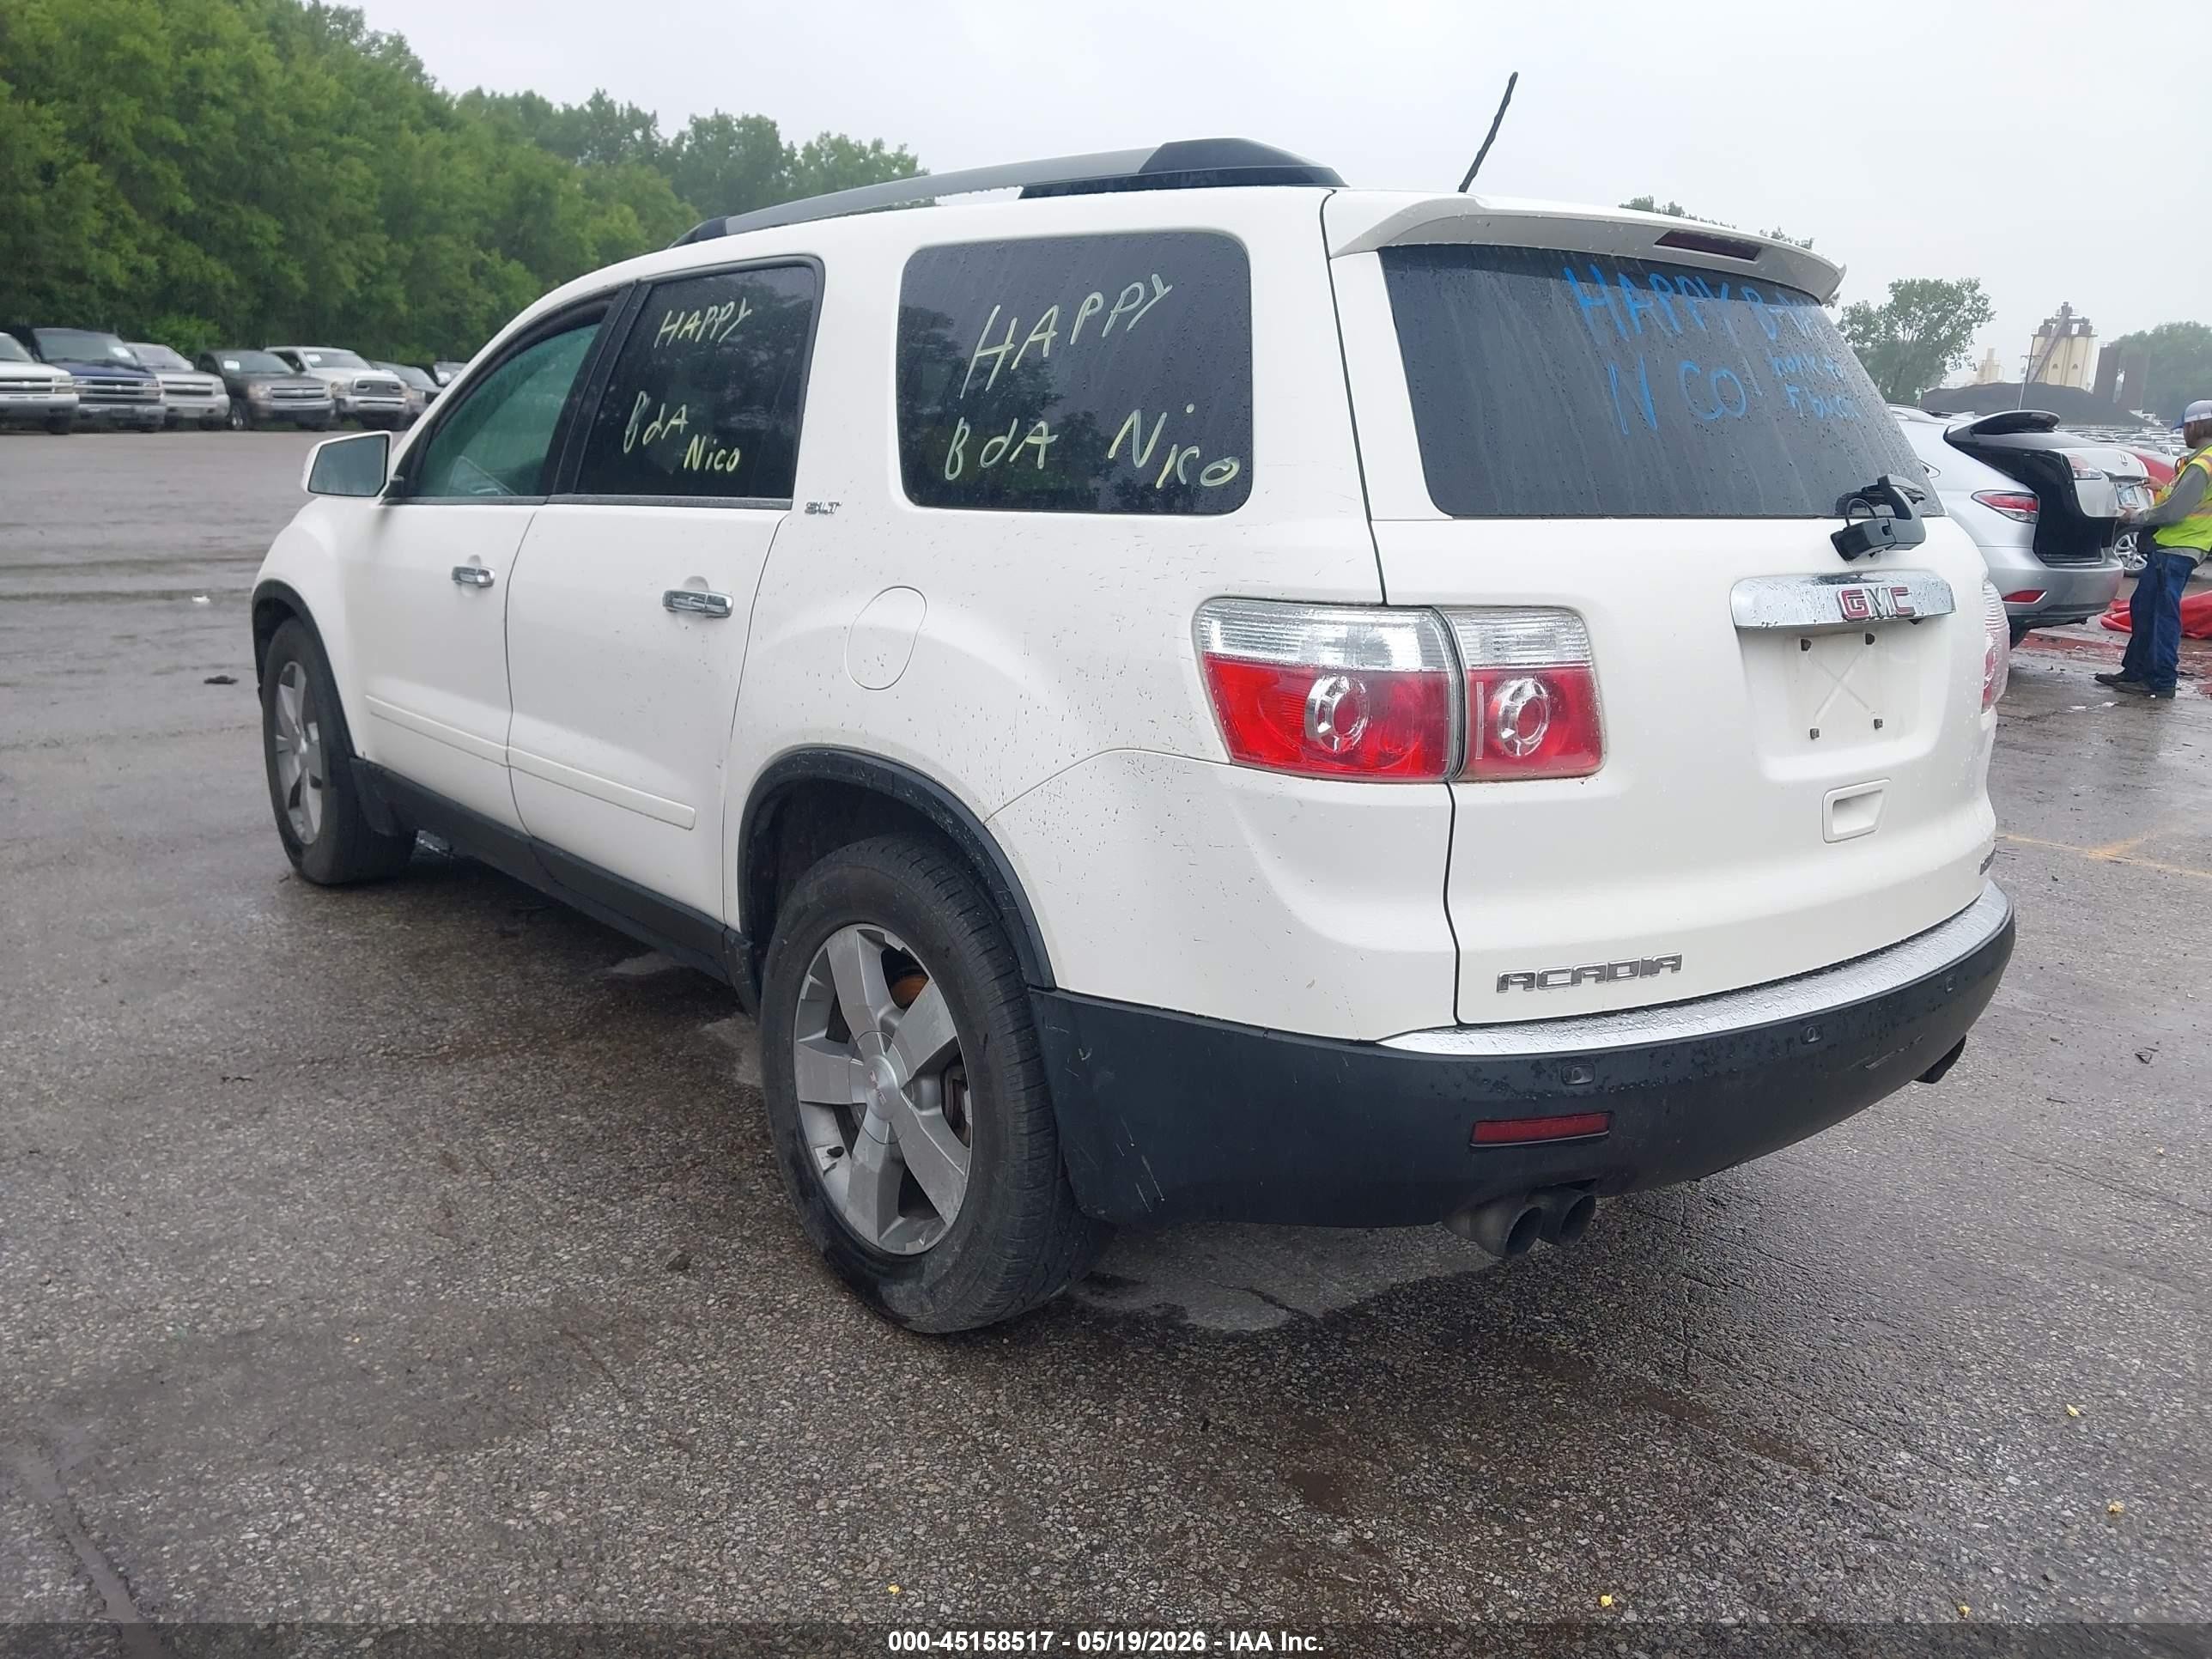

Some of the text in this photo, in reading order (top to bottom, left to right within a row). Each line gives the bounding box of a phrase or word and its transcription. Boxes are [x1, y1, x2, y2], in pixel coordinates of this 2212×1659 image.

[654, 297, 751, 348] HAPPY
[960, 273, 1172, 399] HAPPY
[684, 434, 740, 472] Nico
[1836, 586, 1917, 622] GMC
[1496, 951, 1683, 994] ACADIA
